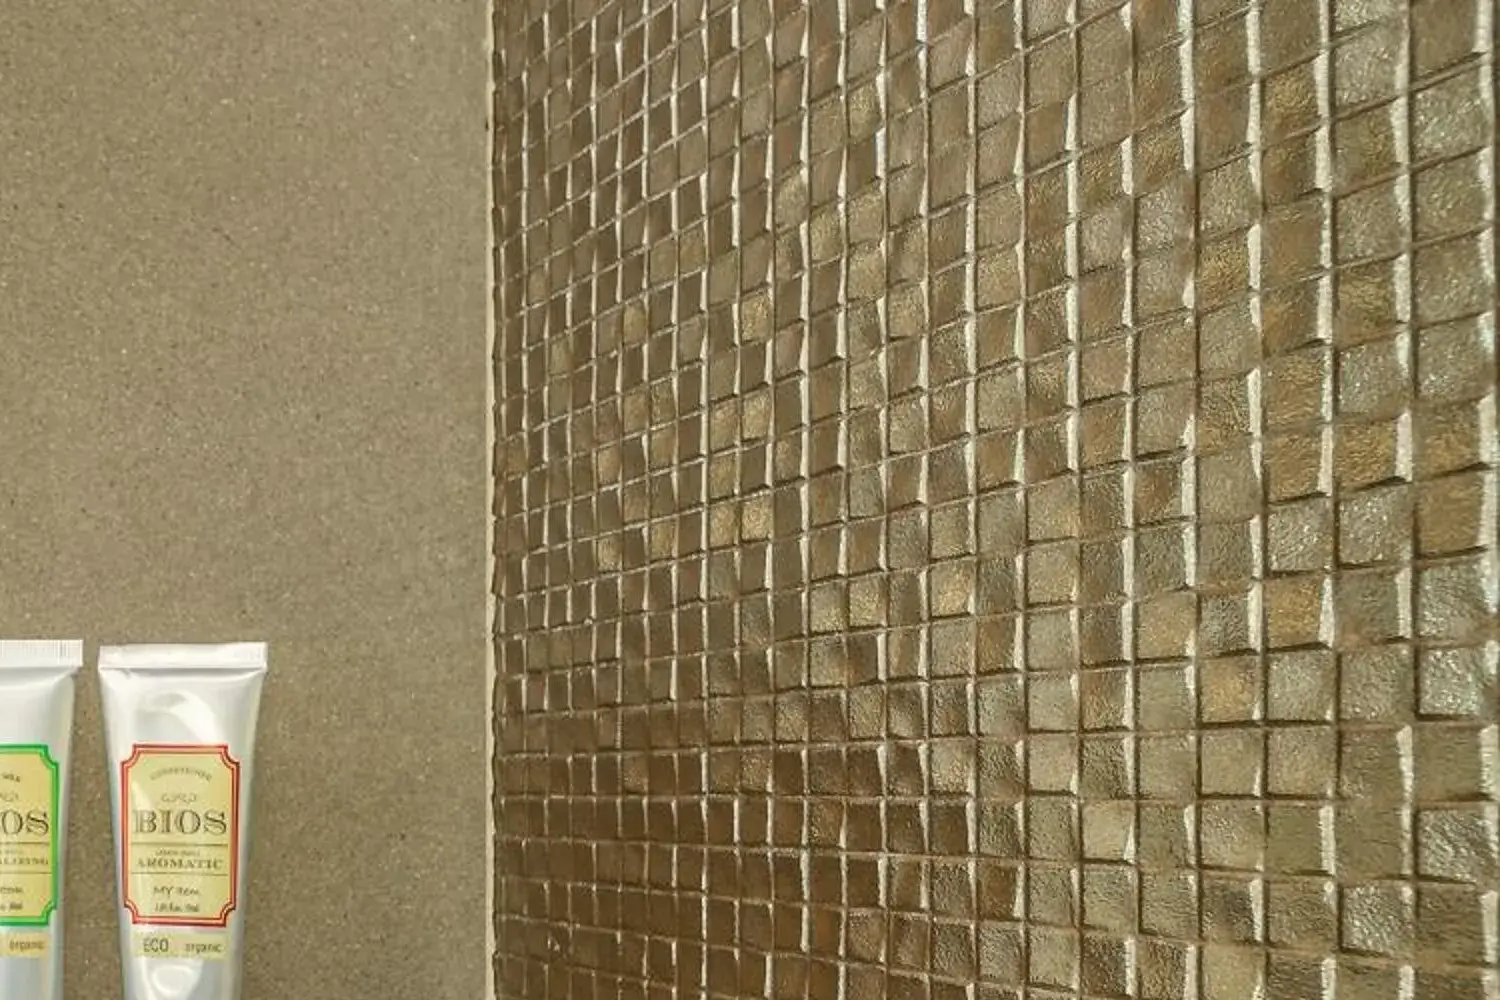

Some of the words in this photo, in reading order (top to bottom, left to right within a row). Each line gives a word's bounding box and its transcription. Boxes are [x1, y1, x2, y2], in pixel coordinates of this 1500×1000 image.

[132, 809, 228, 836] BIOS
[137, 857, 224, 869] AROMATIC
[9, 939, 45, 952] organic
[142, 937, 169, 953] ECO
[185, 942, 223, 954] organic
